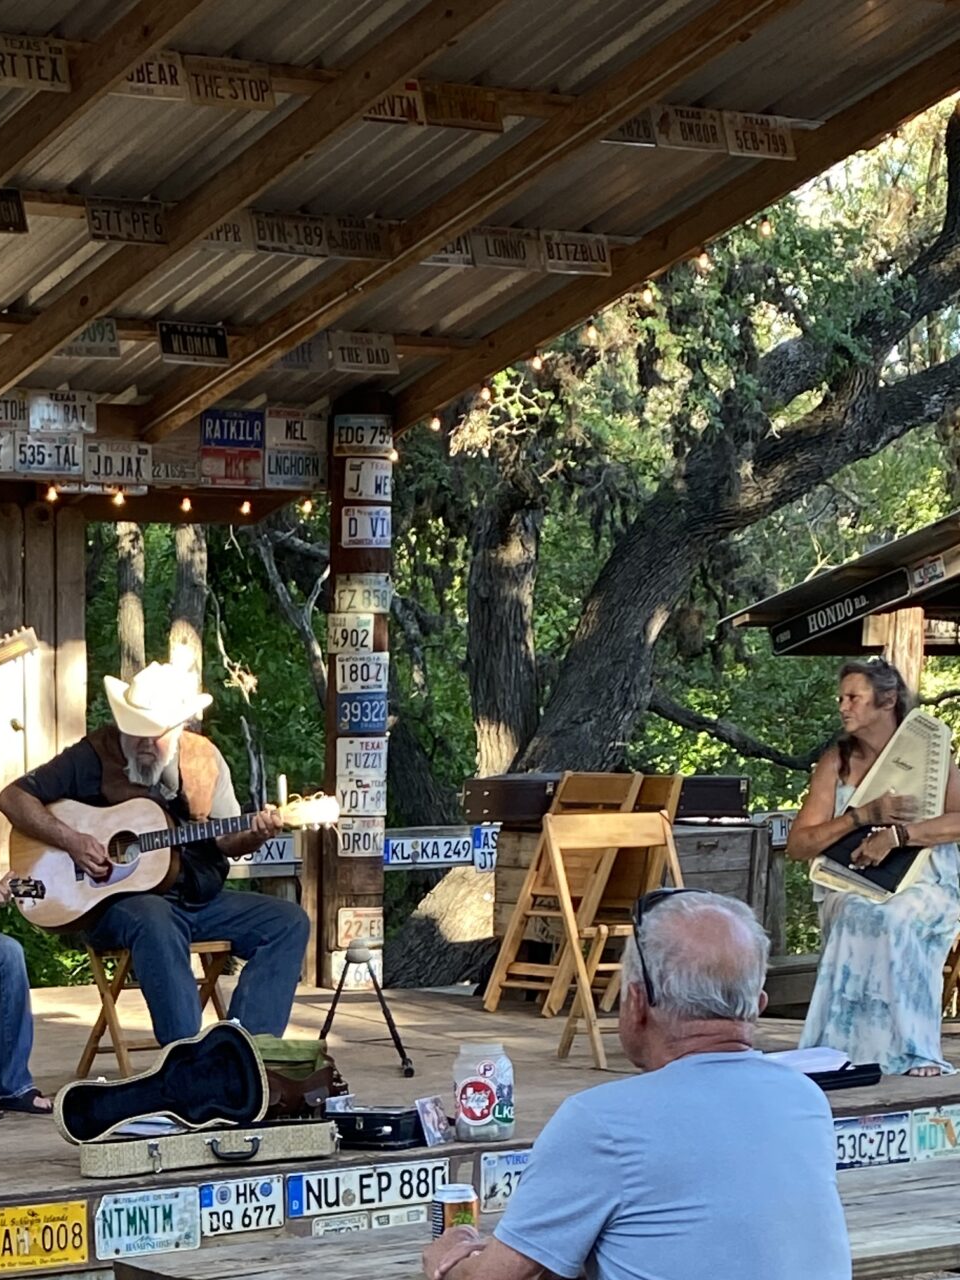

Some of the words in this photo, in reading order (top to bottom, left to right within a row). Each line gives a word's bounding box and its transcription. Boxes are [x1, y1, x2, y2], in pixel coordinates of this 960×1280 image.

[192, 71, 224, 99] THE
[228, 74, 270, 103] STOP
[338, 345, 366, 365] THE
[366, 347, 391, 366] DAD
[49, 393, 77, 403] TEXAS
[205, 418, 262, 441] RATKILR
[807, 598, 854, 634] HONDO
[341, 701, 386, 723] 39322
[391, 843, 411, 860] KL
[420, 841, 440, 859] KA
[443, 839, 471, 859] 249
[875, 1128, 908, 1158] ZP2
[235, 1182, 261, 1205] HK
[304, 1178, 342, 1213] NU
[359, 1171, 392, 1205] EP
[102, 1203, 174, 1240] NTMNTM
[241, 1203, 276, 1229] 677
[41, 1221, 84, 1253] 008
